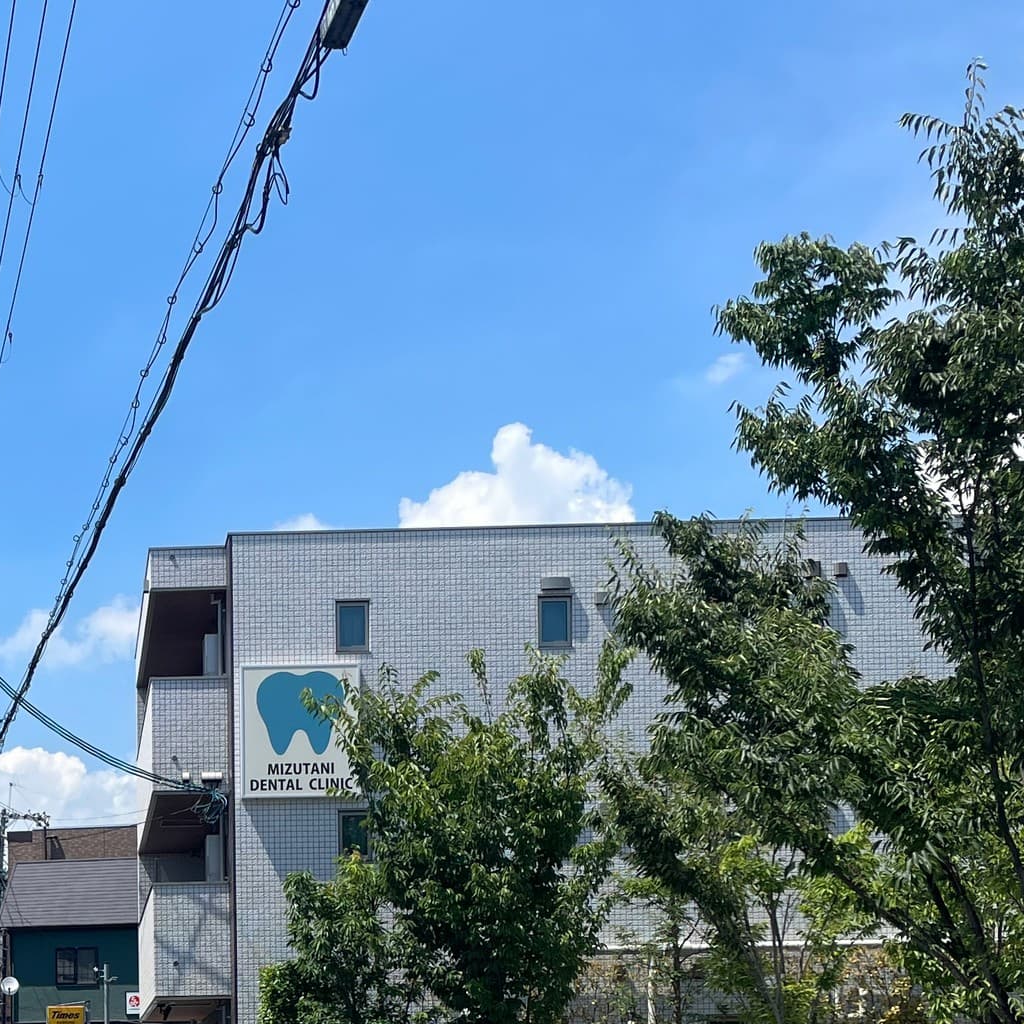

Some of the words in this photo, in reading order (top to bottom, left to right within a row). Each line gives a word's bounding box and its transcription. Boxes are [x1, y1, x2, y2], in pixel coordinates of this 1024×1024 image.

[267, 762, 335, 775] MIZUTANI
[250, 779, 302, 791] DENTAL
[309, 778, 353, 790] CLINIC
[51, 1010, 81, 1020] Times
